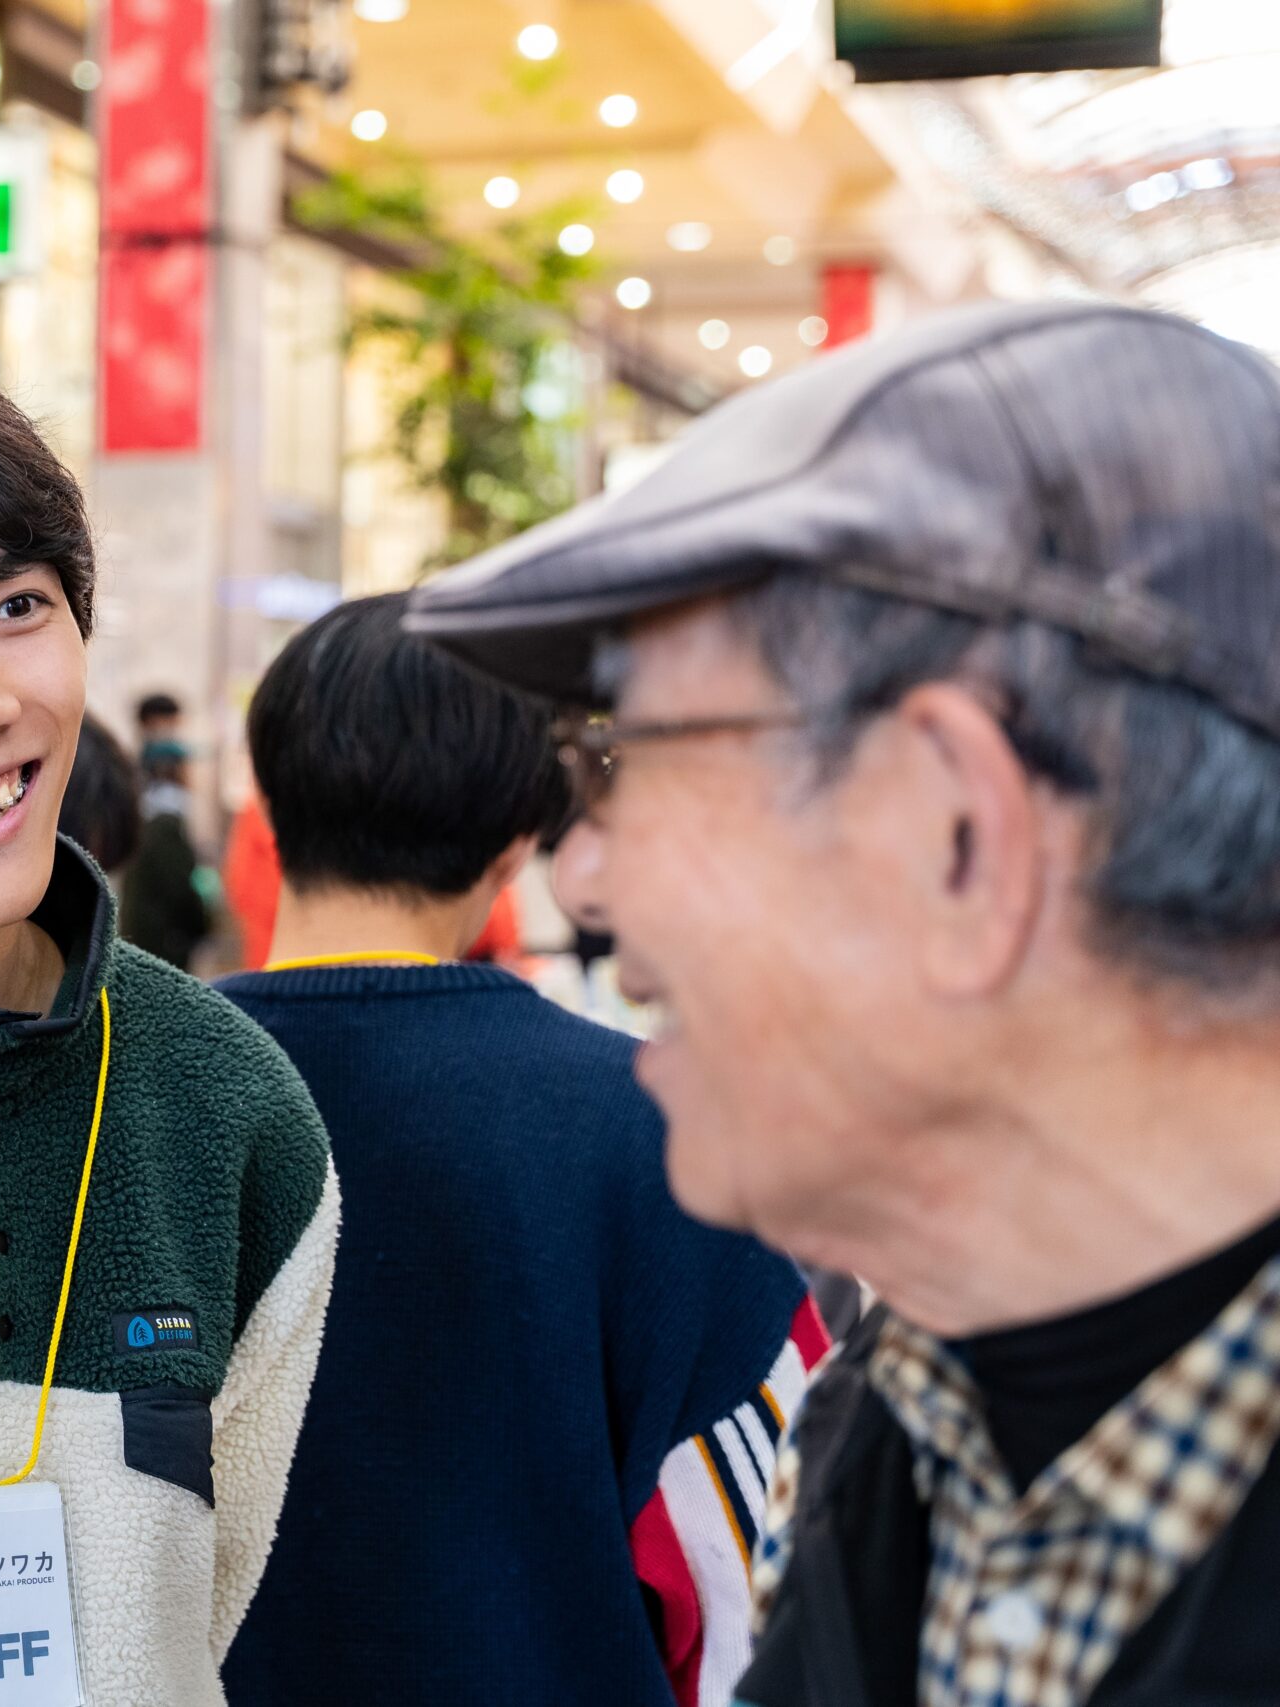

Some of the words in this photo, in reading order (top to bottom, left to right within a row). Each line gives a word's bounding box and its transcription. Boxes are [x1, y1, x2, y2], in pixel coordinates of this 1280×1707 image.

[156, 1317, 191, 1328] SIERRA
[158, 1329, 193, 1340] DESIGNS
[17, 1576, 55, 1586] PRODUCE!
